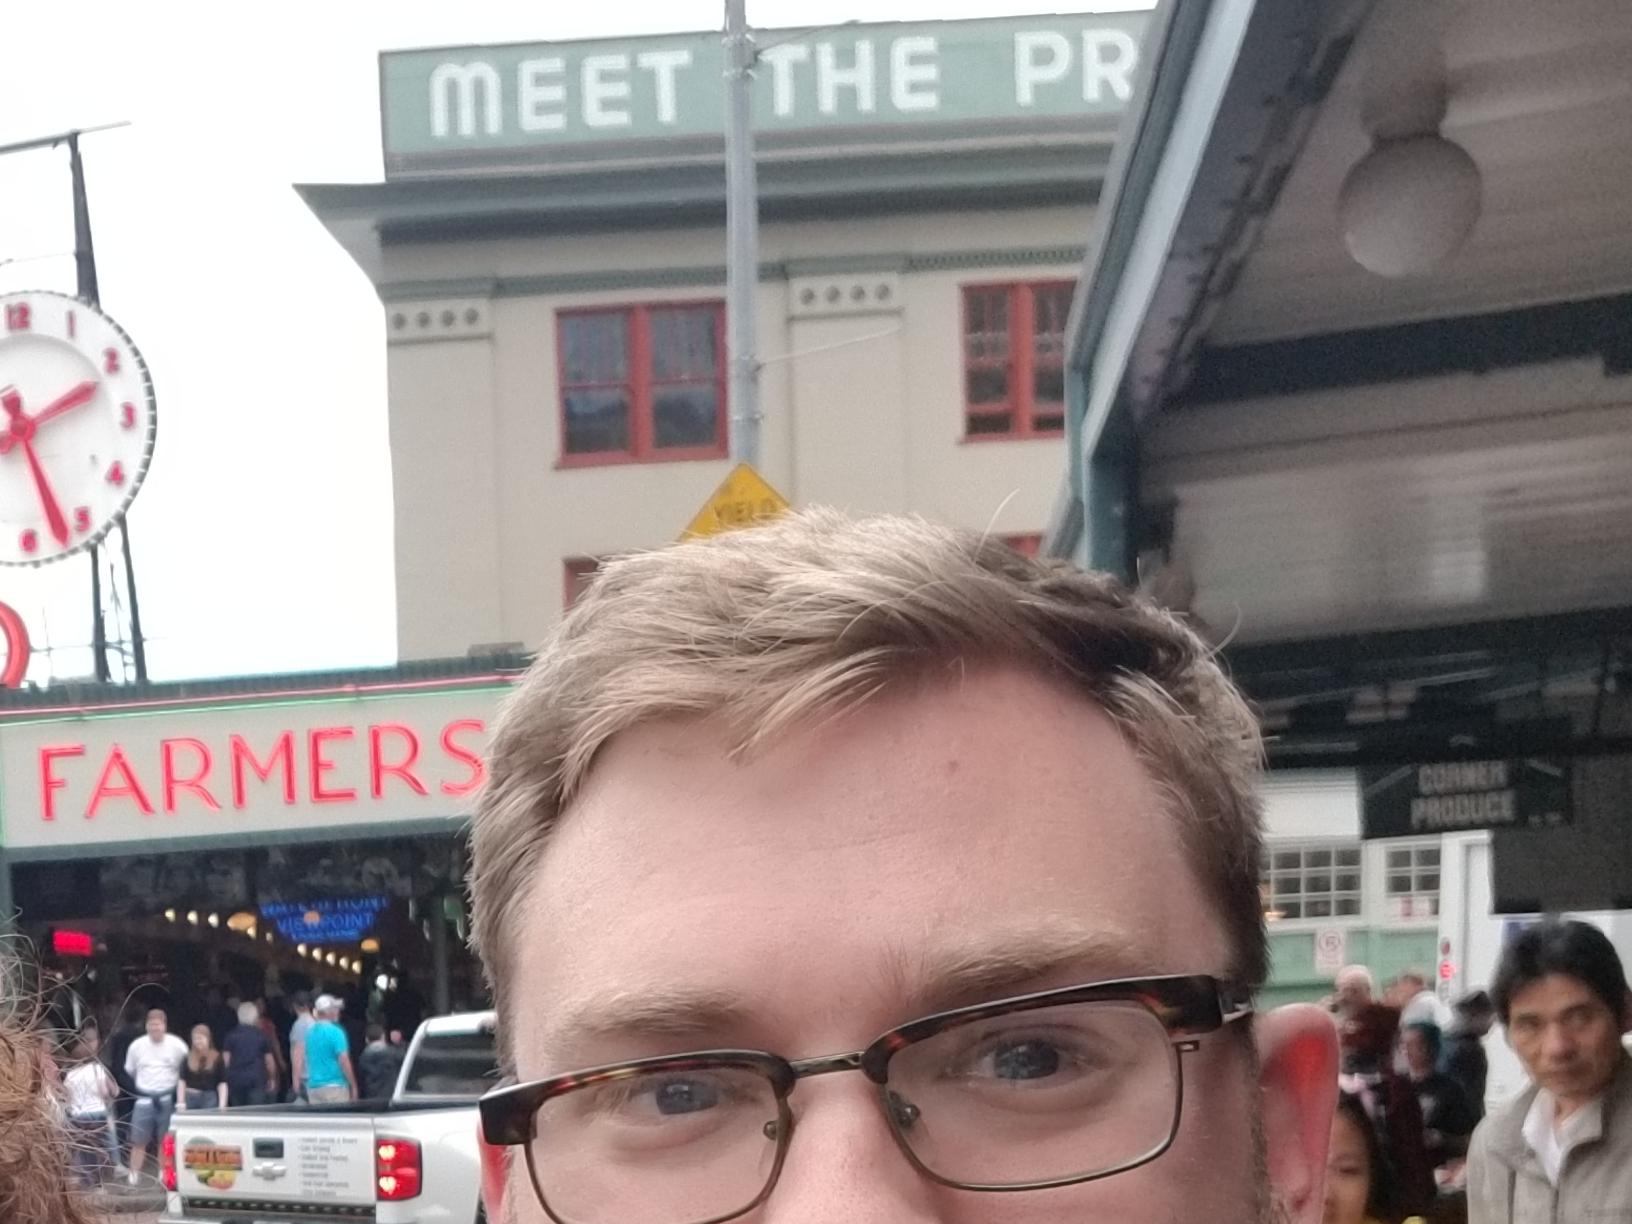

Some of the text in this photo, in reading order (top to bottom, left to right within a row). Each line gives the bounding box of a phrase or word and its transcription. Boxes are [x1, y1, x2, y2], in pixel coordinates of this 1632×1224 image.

[429, 49, 691, 138] MEET
[765, 36, 941, 119] THE
[4, 302, 31, 331] 12
[104, 348, 120, 375] 2
[121, 402, 137, 430] 3
[106, 460, 124, 486] 4
[38, 719, 487, 821] FARMERS
